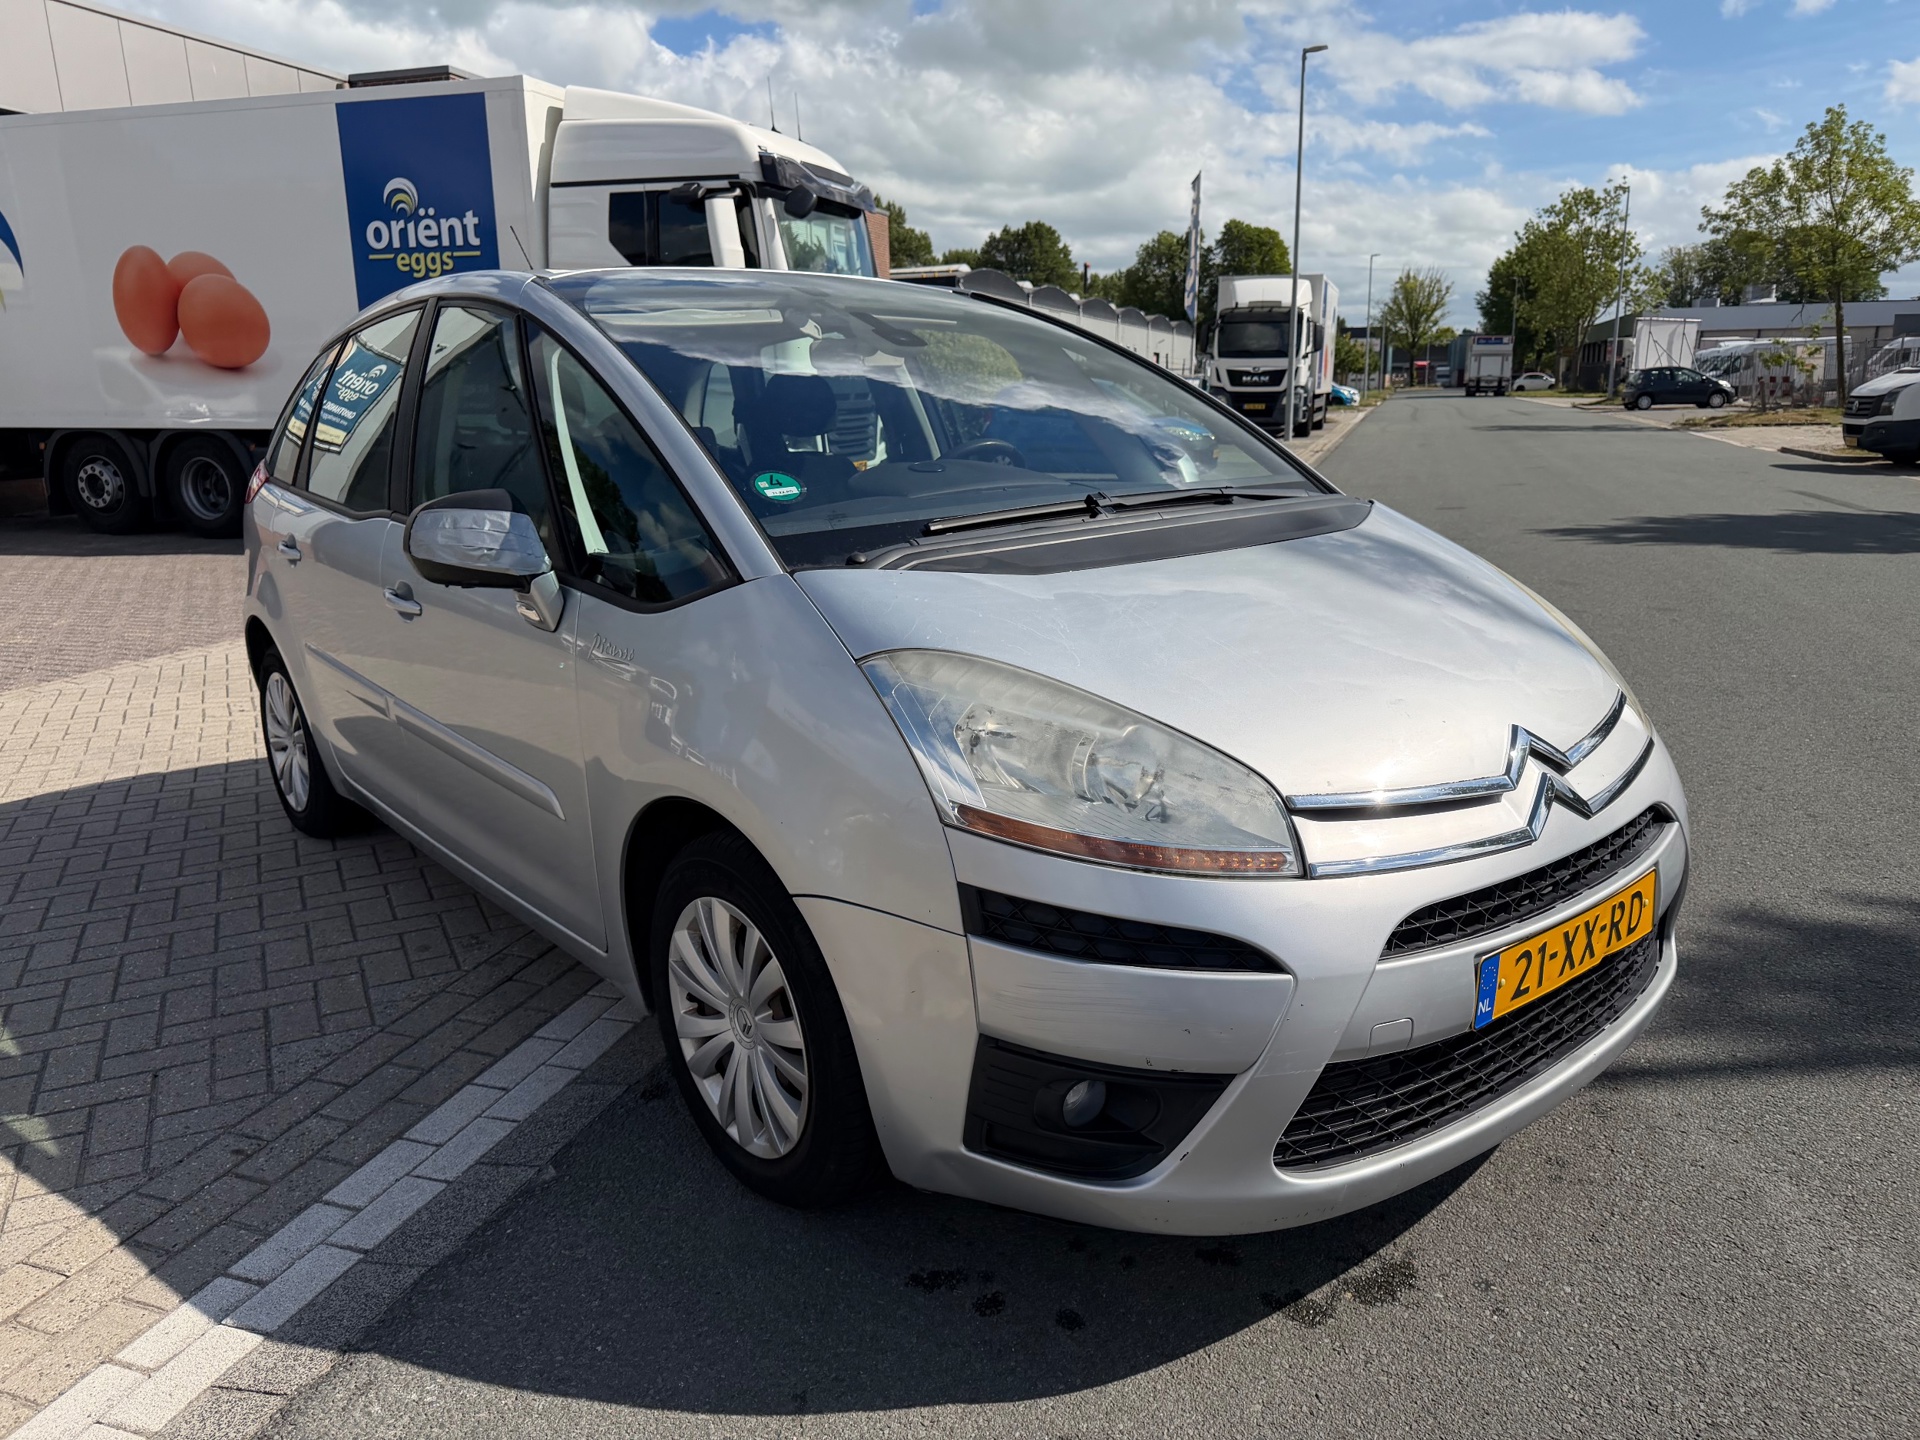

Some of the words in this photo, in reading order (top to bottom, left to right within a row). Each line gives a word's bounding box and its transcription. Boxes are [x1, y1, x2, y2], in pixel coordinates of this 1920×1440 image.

[366, 207, 481, 250] oriënt
[396, 251, 454, 278] eggs
[1242, 375, 1270, 383] MAN
[769, 474, 783, 487] 4
[587, 632, 635, 662] Picasso
[1510, 890, 1643, 1000] 21-XX-RD
[1477, 998, 1492, 1016] NL
